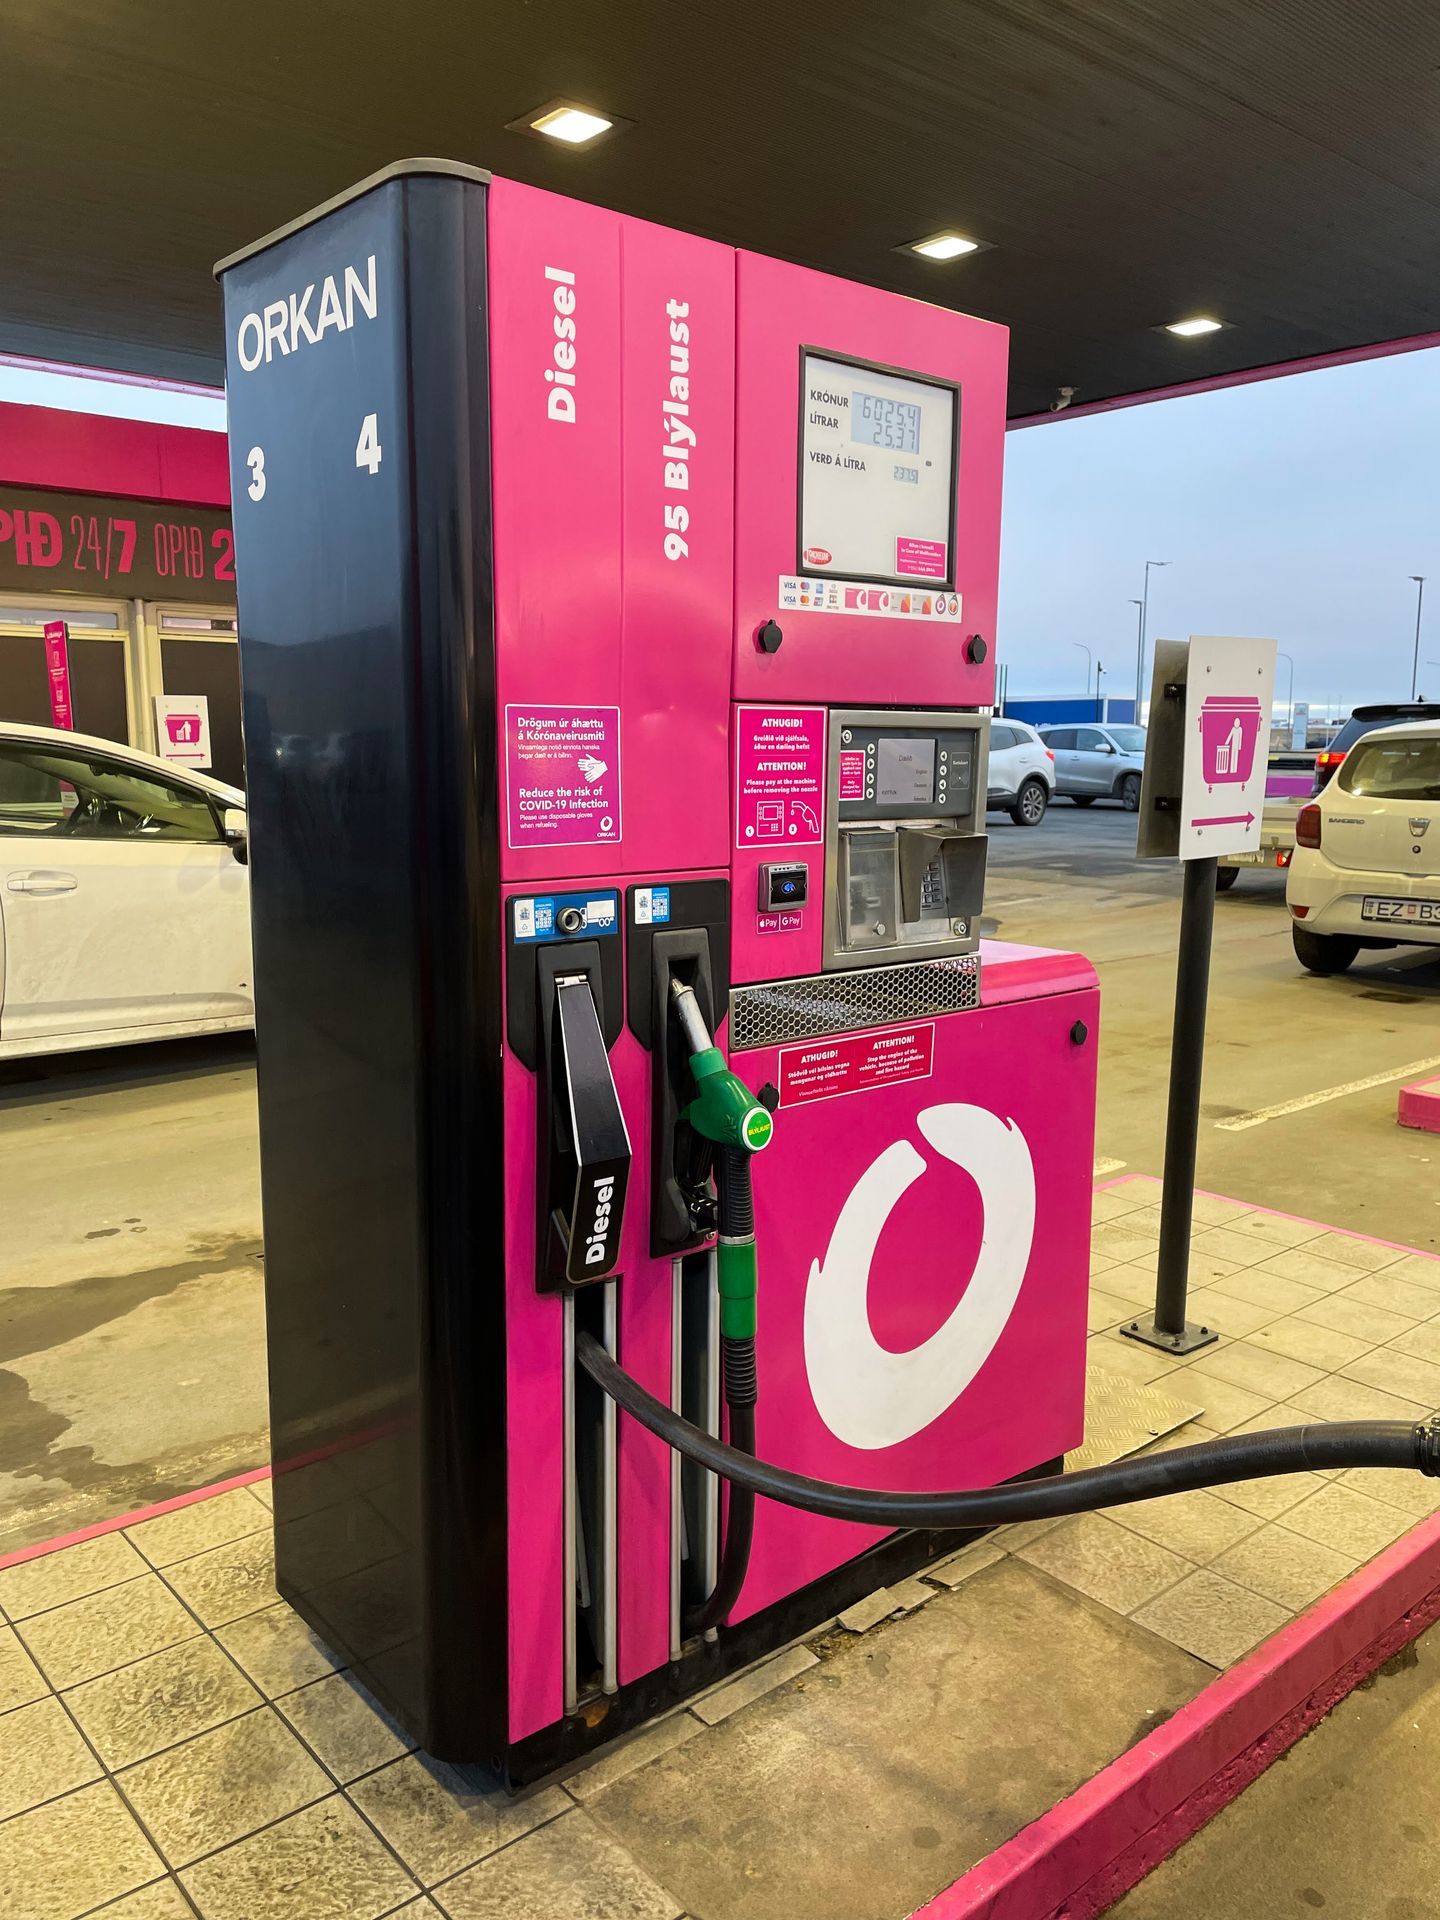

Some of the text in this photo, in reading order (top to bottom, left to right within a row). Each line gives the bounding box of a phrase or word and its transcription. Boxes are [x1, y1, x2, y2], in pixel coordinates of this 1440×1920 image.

[238, 255, 377, 372] ORKAN
[544, 266, 576, 424] Diesel
[810, 390, 849, 408] KRÓNUR
[810, 411, 839, 429] LÍTRAR
[662, 298, 697, 561] 95 Blýlaust
[355, 413, 382, 475] 4
[810, 451, 866, 471] VERÐ Á LÍTRA
[247, 446, 267, 502] 3
[70, 514, 137, 580] 24/7
[154, 523, 204, 579] OPIÐ
[784, 582, 797, 590] VISA
[784, 595, 797, 603] VISA
[518, 717, 604, 730] Drögum úr áhættu
[518, 730, 605, 741] á Kórónaveirusmiti
[757, 762, 807, 771] ATTENTION!
[519, 785, 603, 798] Reduce the risk of
[763, 786, 790, 794] removing
[519, 798, 608, 811] COVID-19 Infection
[1377, 902, 1404, 917] EZ
[765, 919, 777, 928] Pay
[782, 916, 800, 926] G Pay
[873, 1035, 915, 1050] ATTENTION!
[585, 1175, 615, 1265] Diesel
